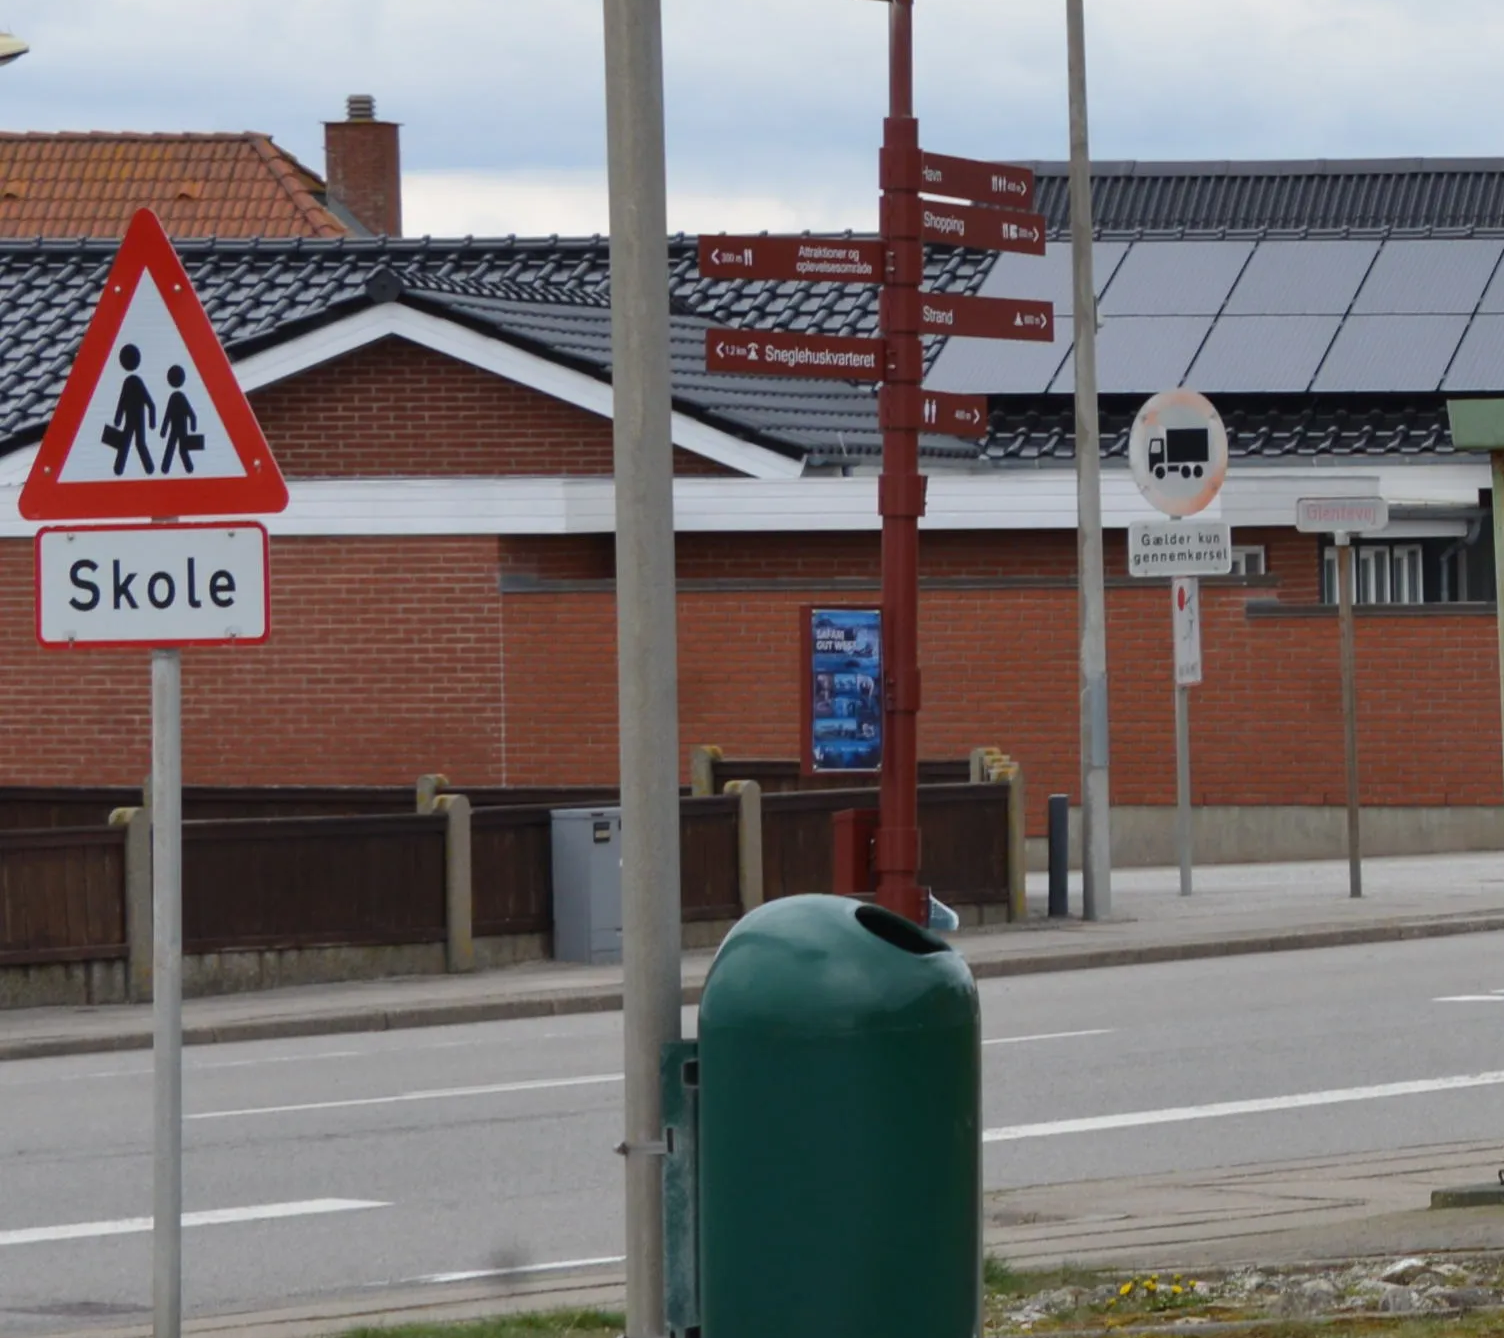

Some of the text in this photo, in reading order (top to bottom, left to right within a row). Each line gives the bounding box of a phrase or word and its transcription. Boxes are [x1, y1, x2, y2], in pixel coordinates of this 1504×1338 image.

[923, 211, 965, 237] Shopping
[798, 245, 860, 262] Attraktioner og
[922, 305, 954, 325] Strand
[764, 344, 875, 367] Sneglehuskvarteret
[1141, 532, 1220, 546] Gælder kun
[1133, 548, 1227, 566] gennemkørsel
[69, 557, 236, 612] Skole
